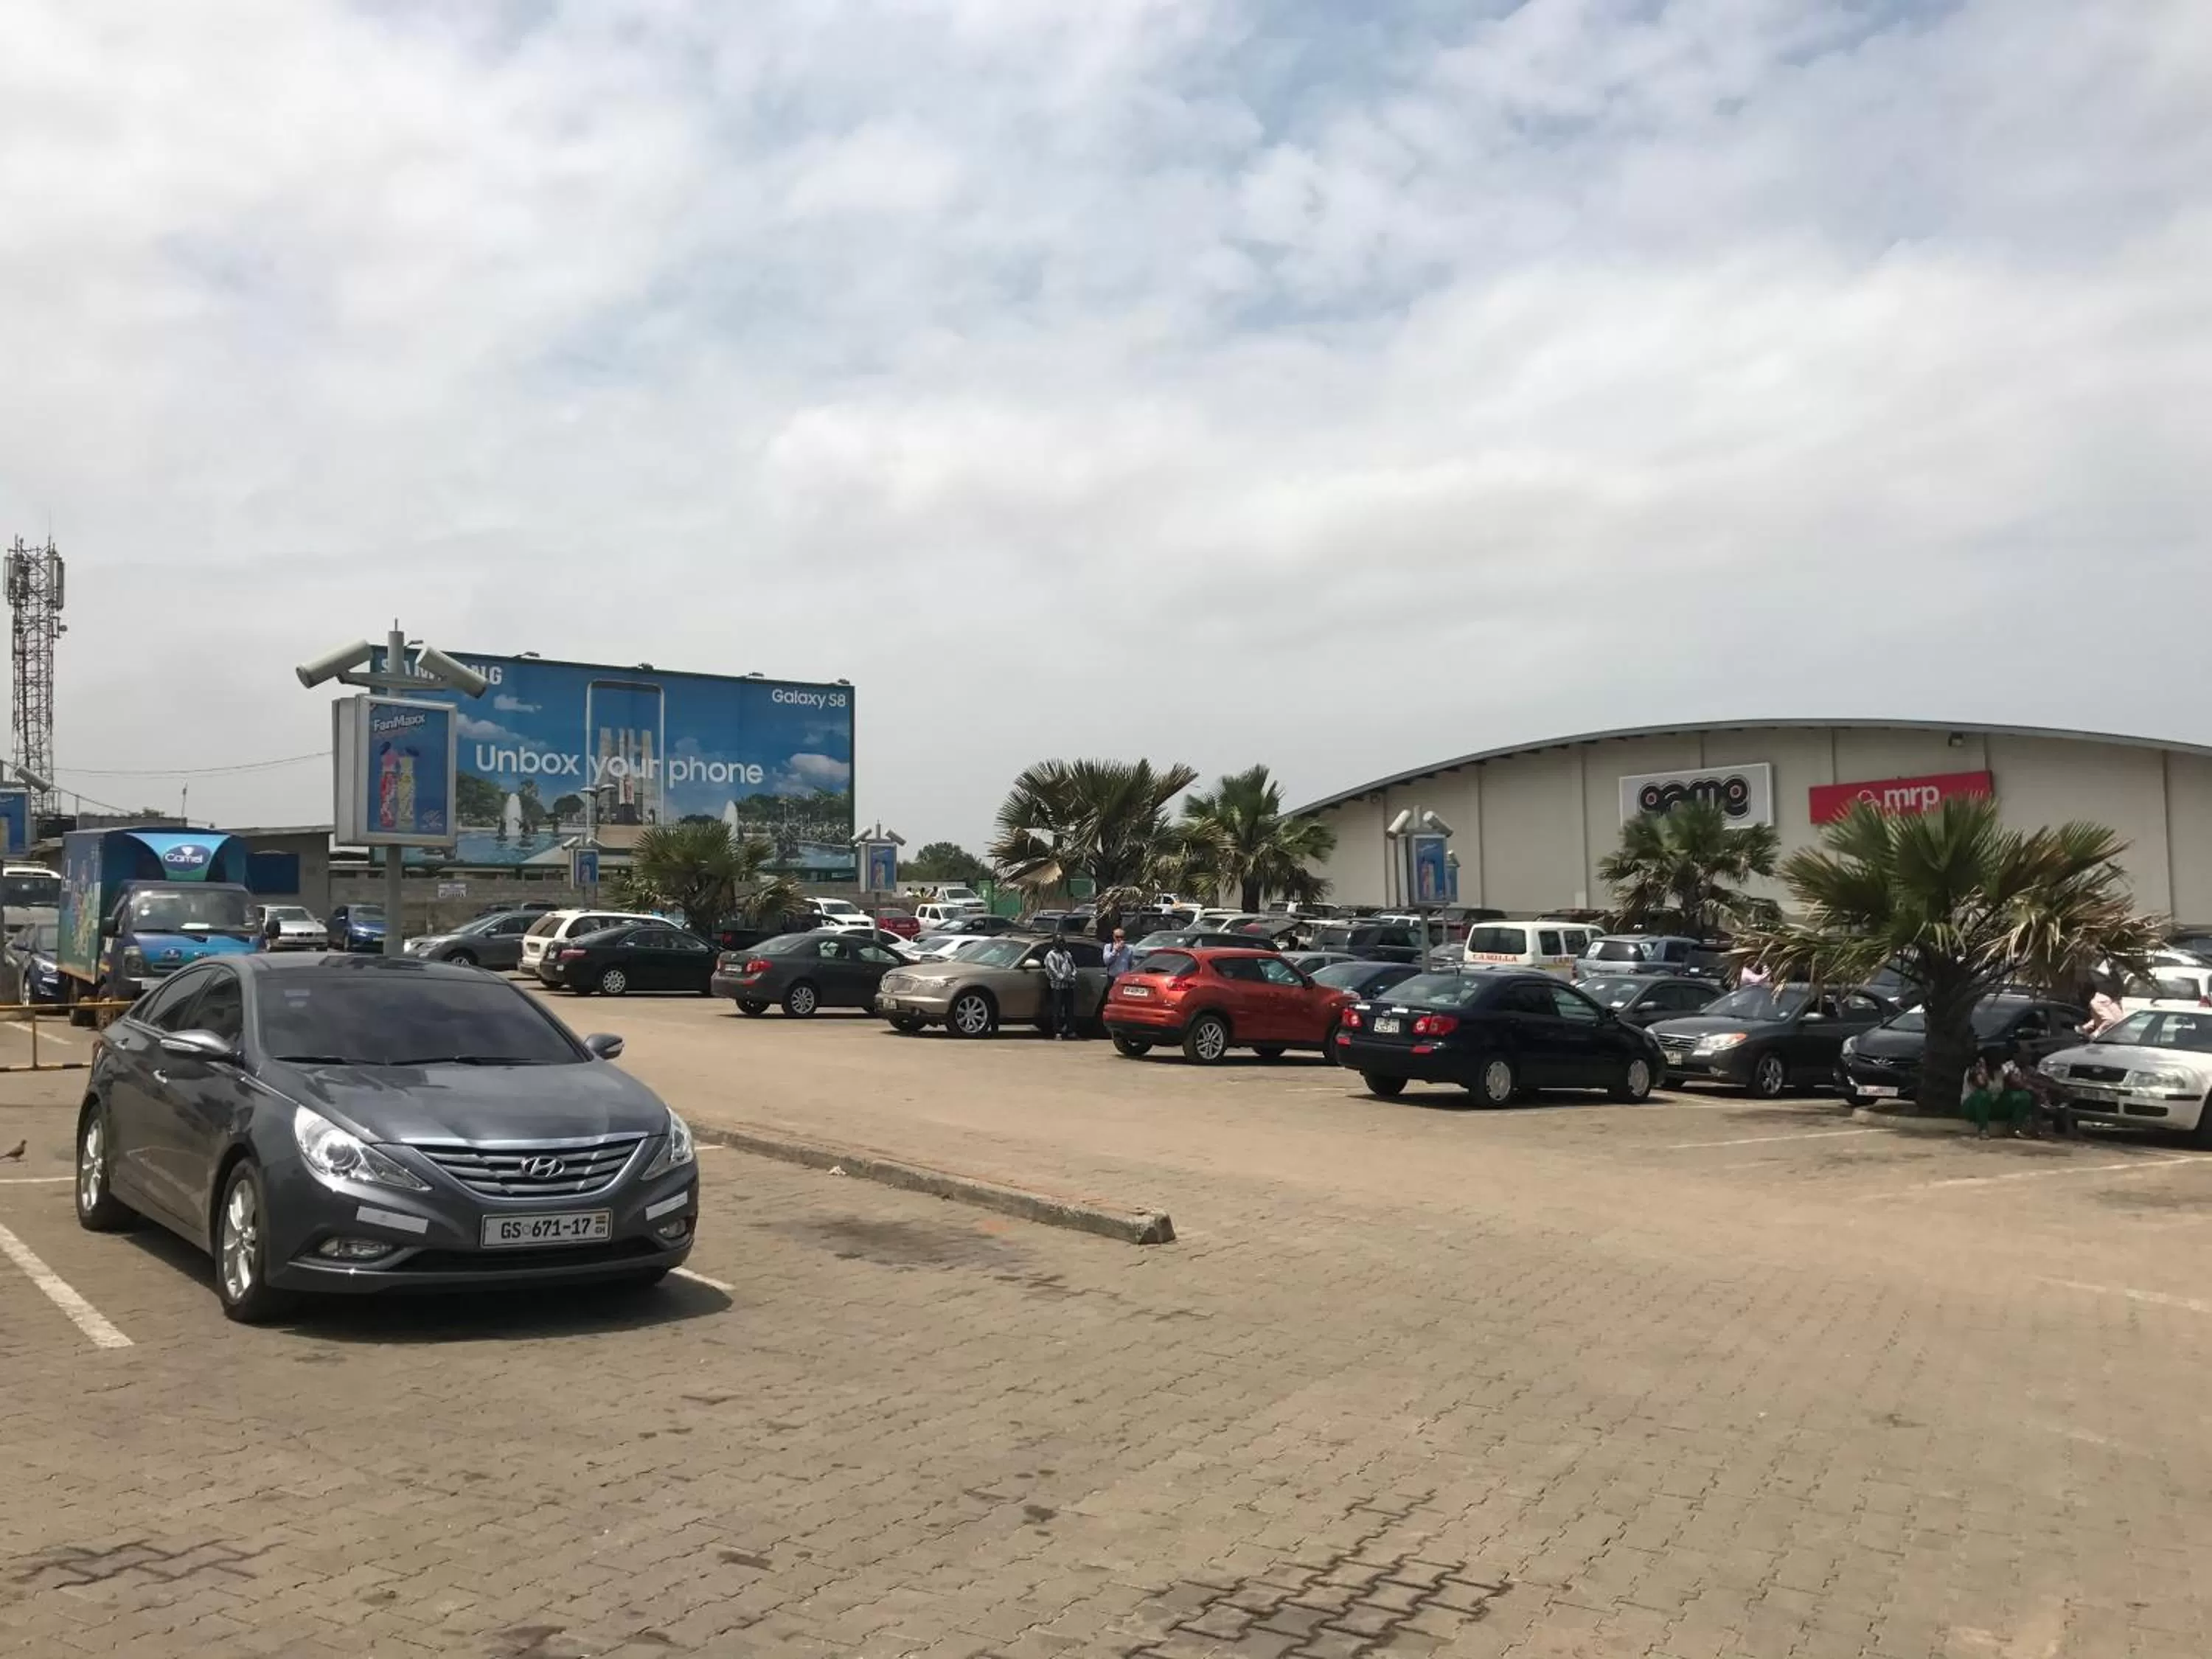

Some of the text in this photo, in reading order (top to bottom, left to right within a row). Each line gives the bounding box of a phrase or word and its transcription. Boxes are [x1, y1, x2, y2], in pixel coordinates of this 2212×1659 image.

[771, 688, 846, 709] Galaxy S8
[373, 714, 425, 733] FanMaxx
[476, 744, 764, 790] Unbox your phone
[1884, 785, 1941, 812] mrp
[1472, 953, 1518, 963] CAMILLA
[501, 1217, 591, 1239] GS 671-17
